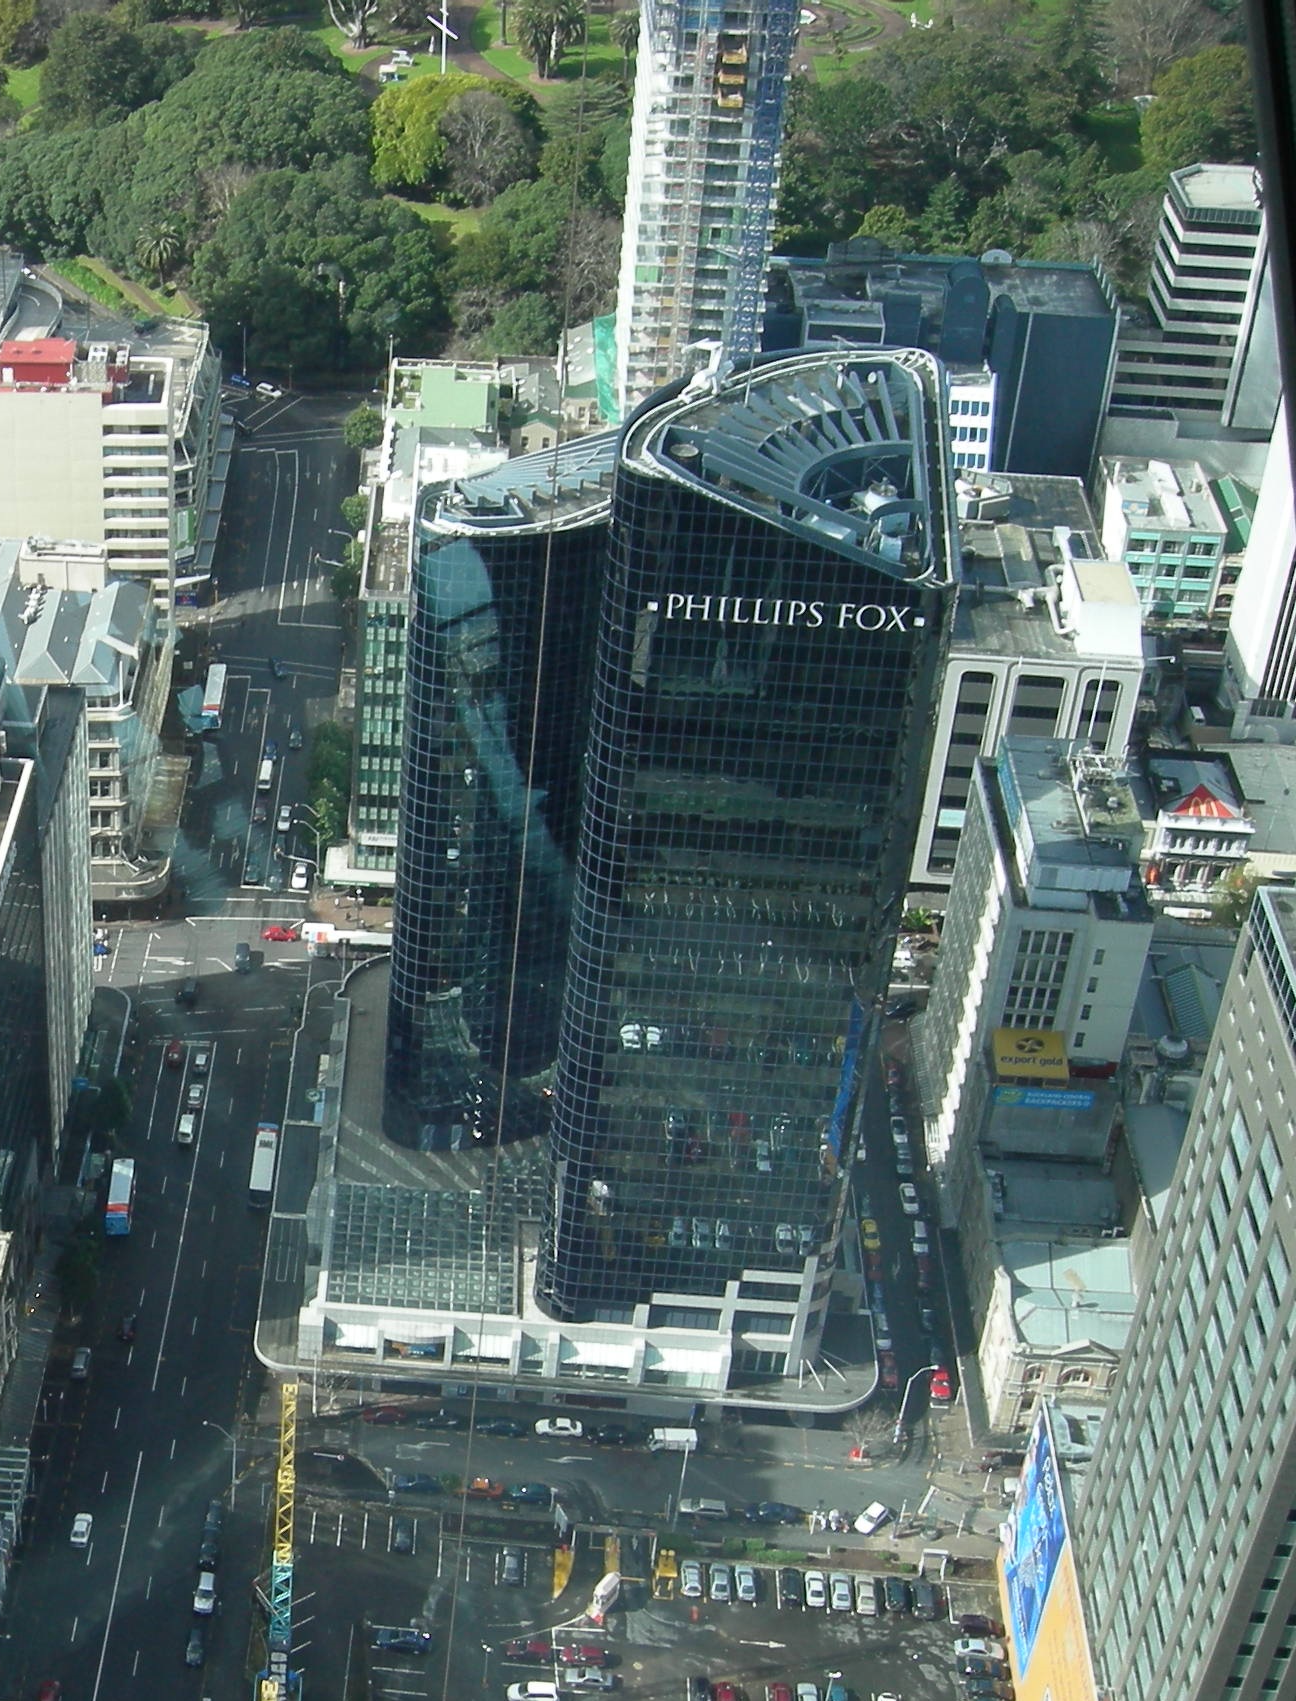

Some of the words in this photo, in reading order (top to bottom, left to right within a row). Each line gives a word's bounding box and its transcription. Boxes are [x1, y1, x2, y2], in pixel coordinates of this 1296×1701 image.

[666, 592, 824, 628] PHILLIPS
[837, 603, 910, 632] FOX
[1001, 1055, 1036, 1065] export
[1039, 1057, 1063, 1067] gold
